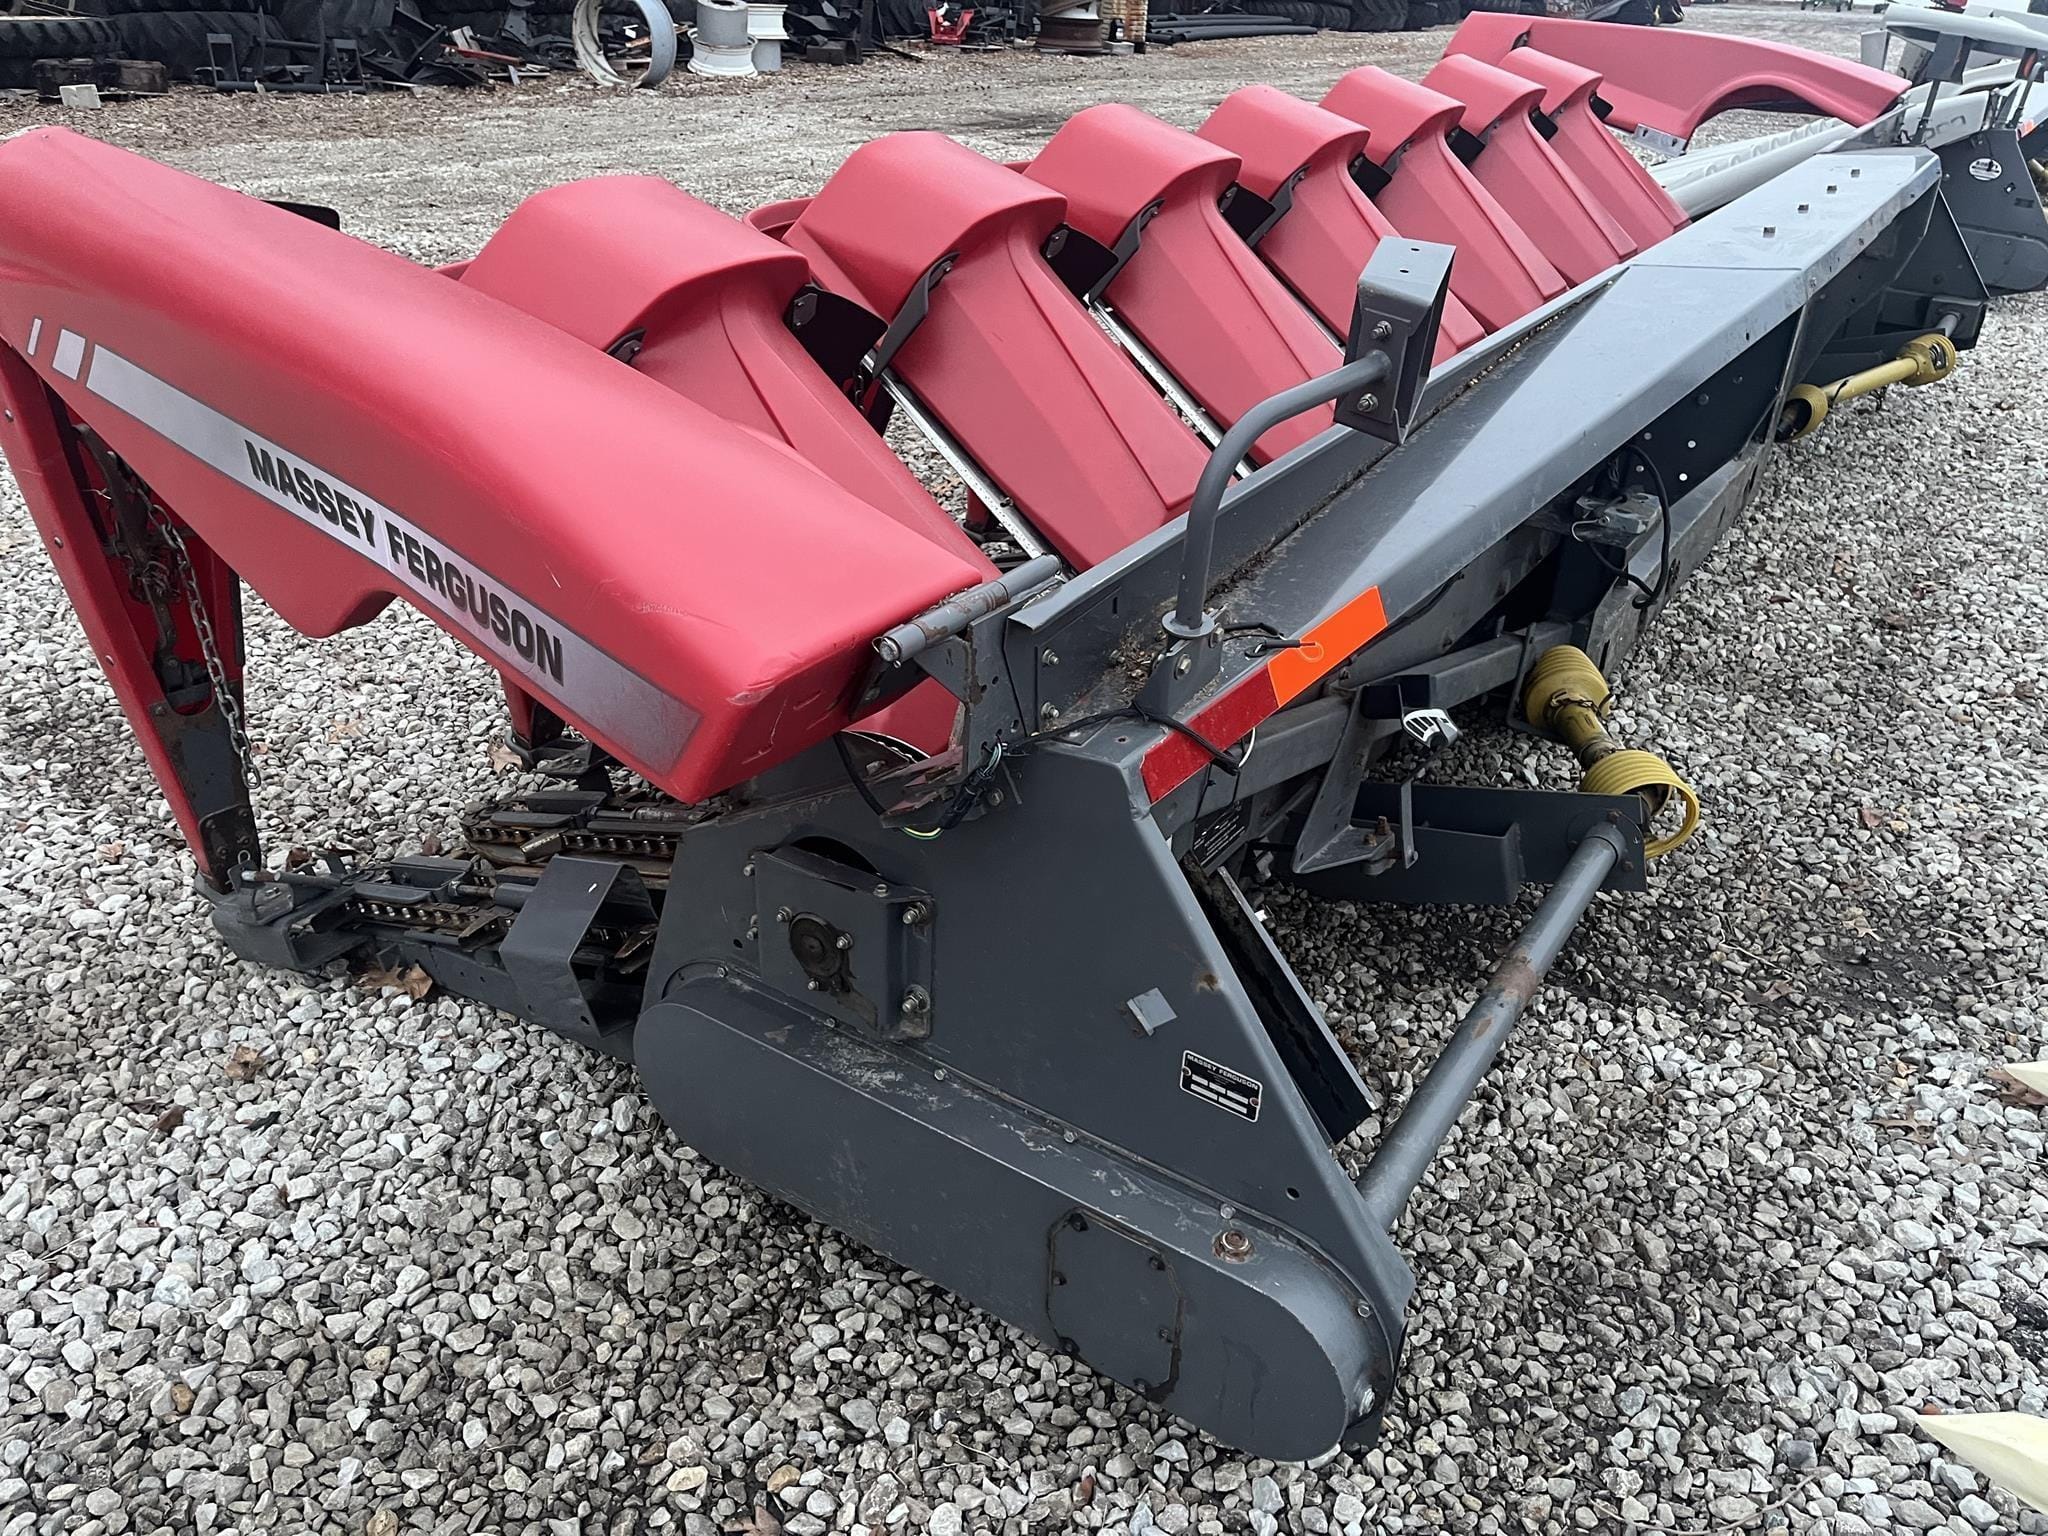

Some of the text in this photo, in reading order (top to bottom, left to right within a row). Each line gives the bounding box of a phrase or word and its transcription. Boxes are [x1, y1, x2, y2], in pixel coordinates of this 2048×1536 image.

[245, 439, 564, 687] MASSEY FERGUSON
[1187, 1054, 1217, 1072] MASSEY
[1218, 1069, 1258, 1091] FERGUSON
